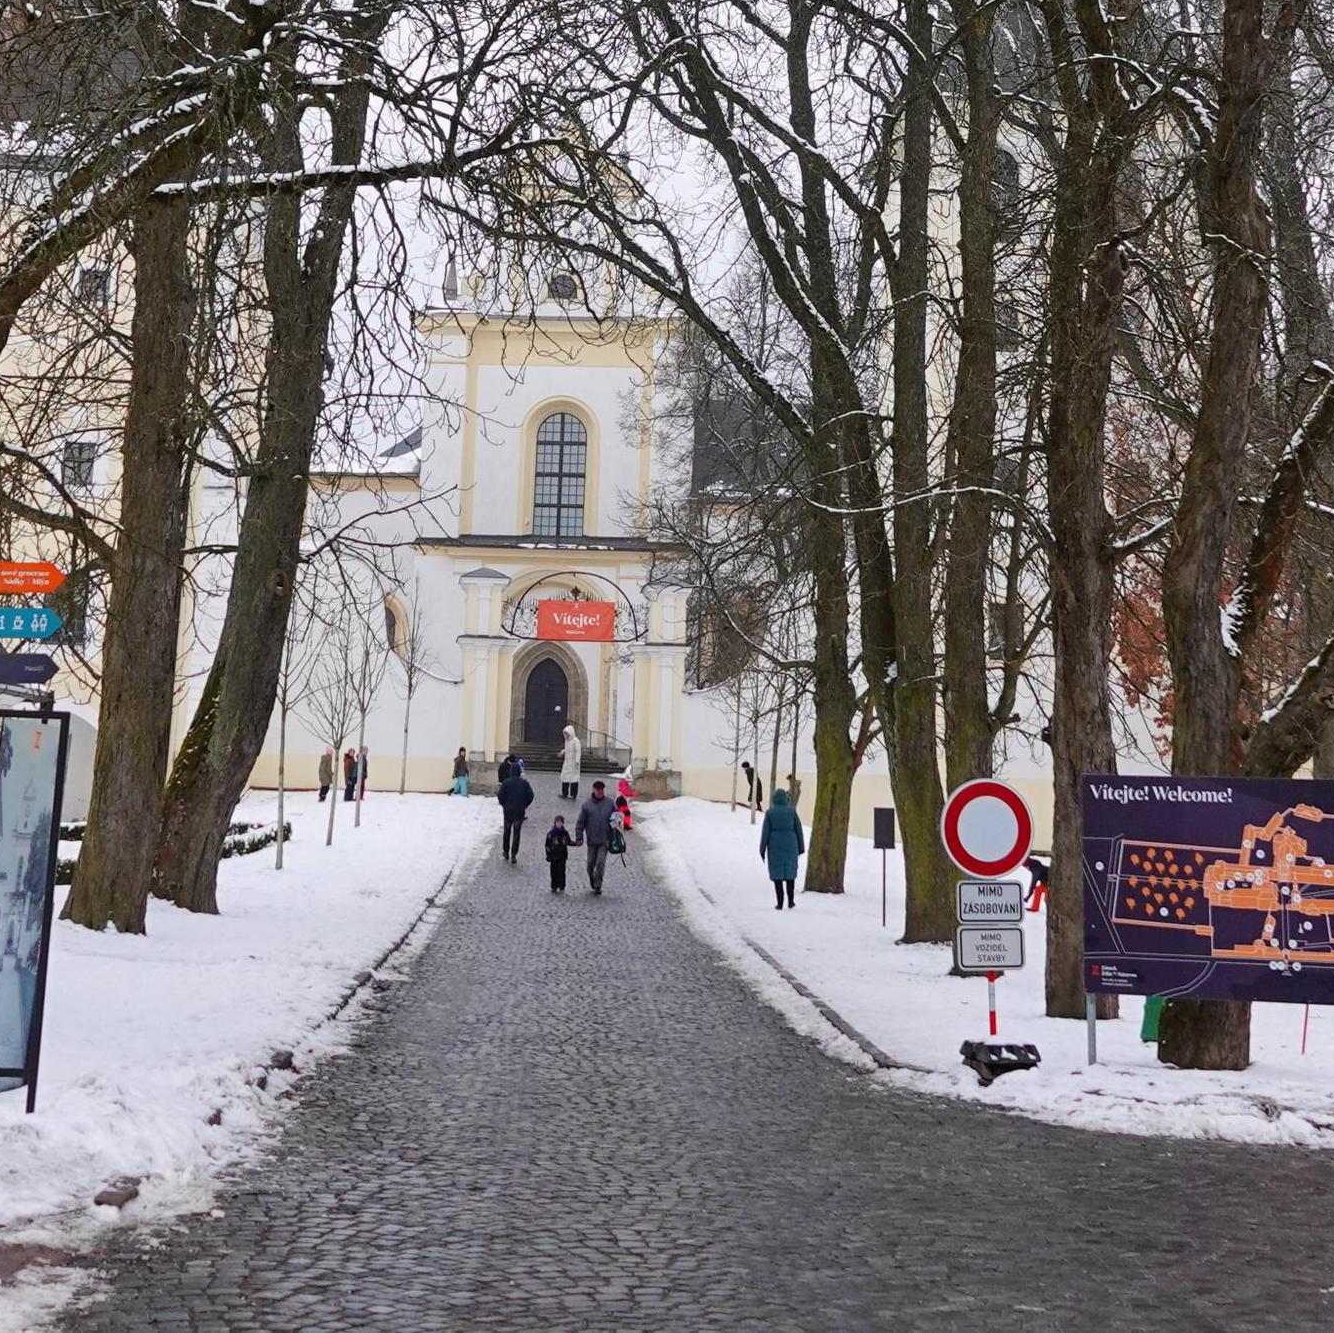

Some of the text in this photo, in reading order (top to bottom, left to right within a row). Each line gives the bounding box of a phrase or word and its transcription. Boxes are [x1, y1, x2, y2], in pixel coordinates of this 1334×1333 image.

[553, 612, 600, 628] Vítejte!
[1089, 783, 1233, 804] Vítejte! Welcome!
[977, 885, 1003, 897] MIMO
[963, 901, 1019, 915] ZÁSOBOVÁNÍ
[980, 933, 1002, 941] MIMO
[975, 944, 1007, 952] VOZIDEL
[977, 954, 1006, 963] STAVBY
